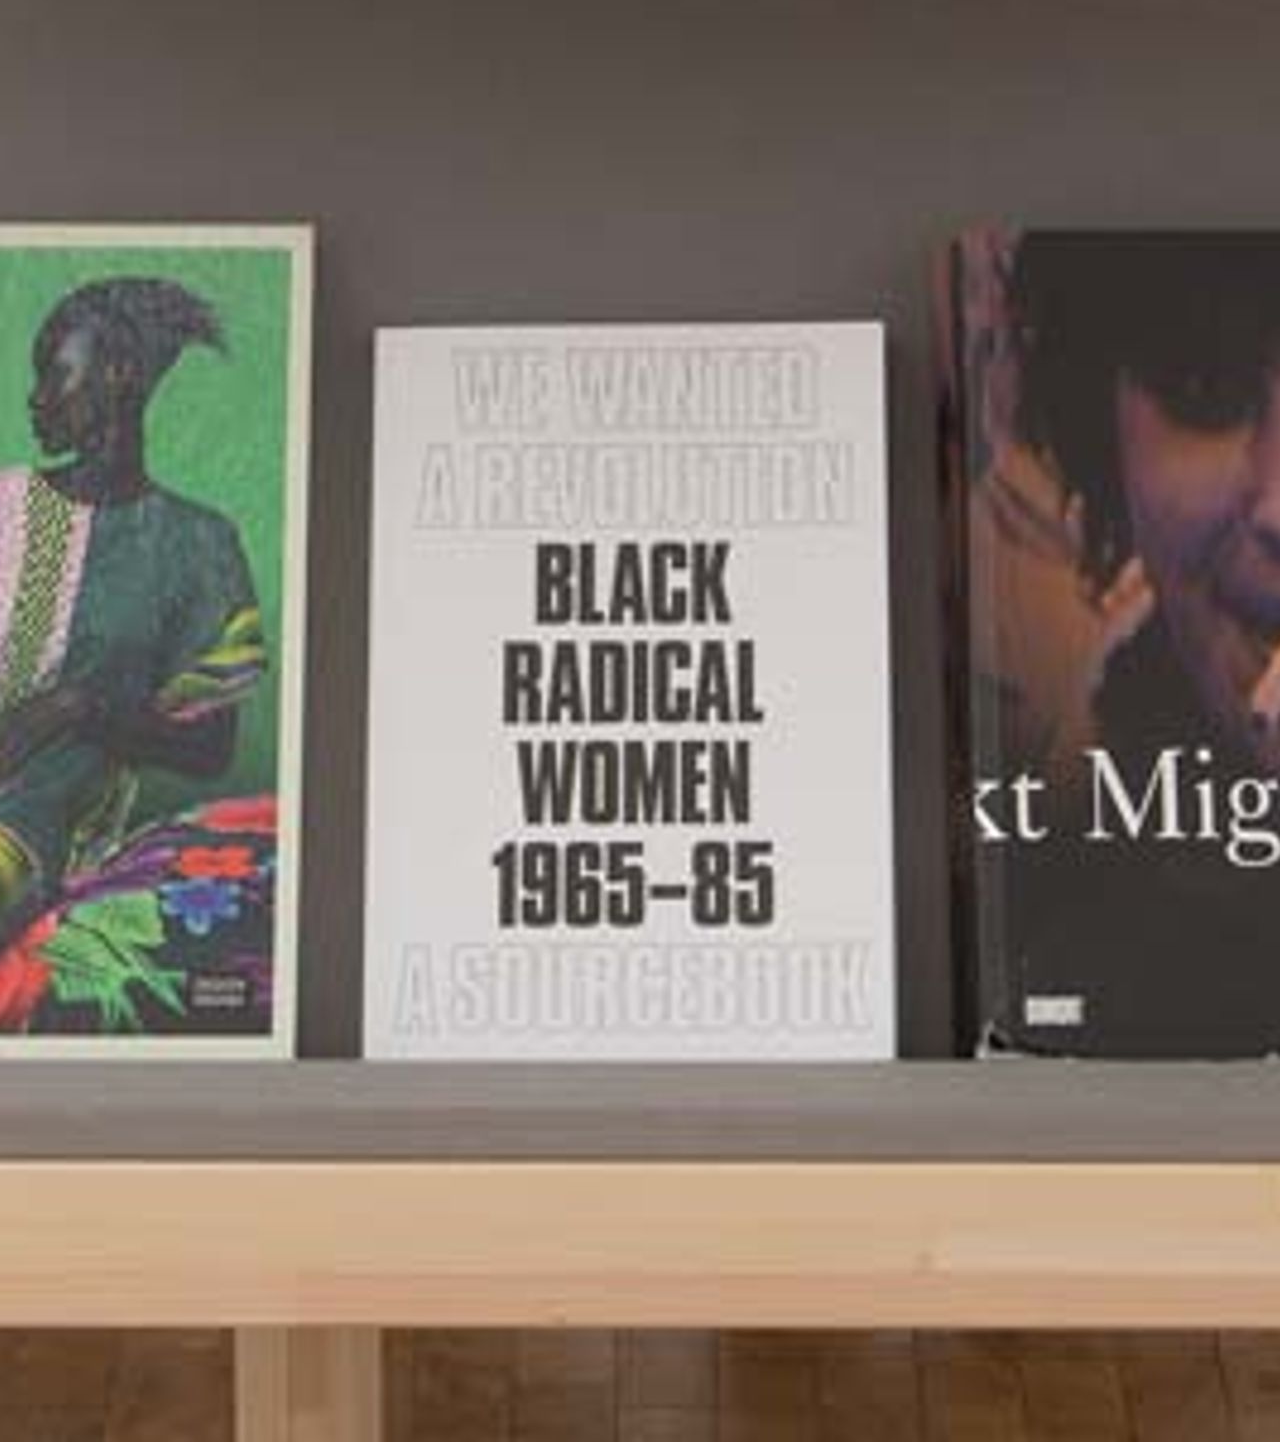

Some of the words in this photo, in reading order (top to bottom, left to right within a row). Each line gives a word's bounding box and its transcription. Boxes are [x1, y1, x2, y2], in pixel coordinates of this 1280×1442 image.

[451, 346, 552, 433] WE
[565, 346, 821, 433] WANTED
[416, 441, 458, 529] A
[472, 441, 857, 529] REVOLUTION
[535, 542, 732, 625] BLACK
[501, 641, 765, 725] RADICAL
[516, 740, 751, 825] WOMEN
[450, 941, 874, 1035] SOURCEBOOK
